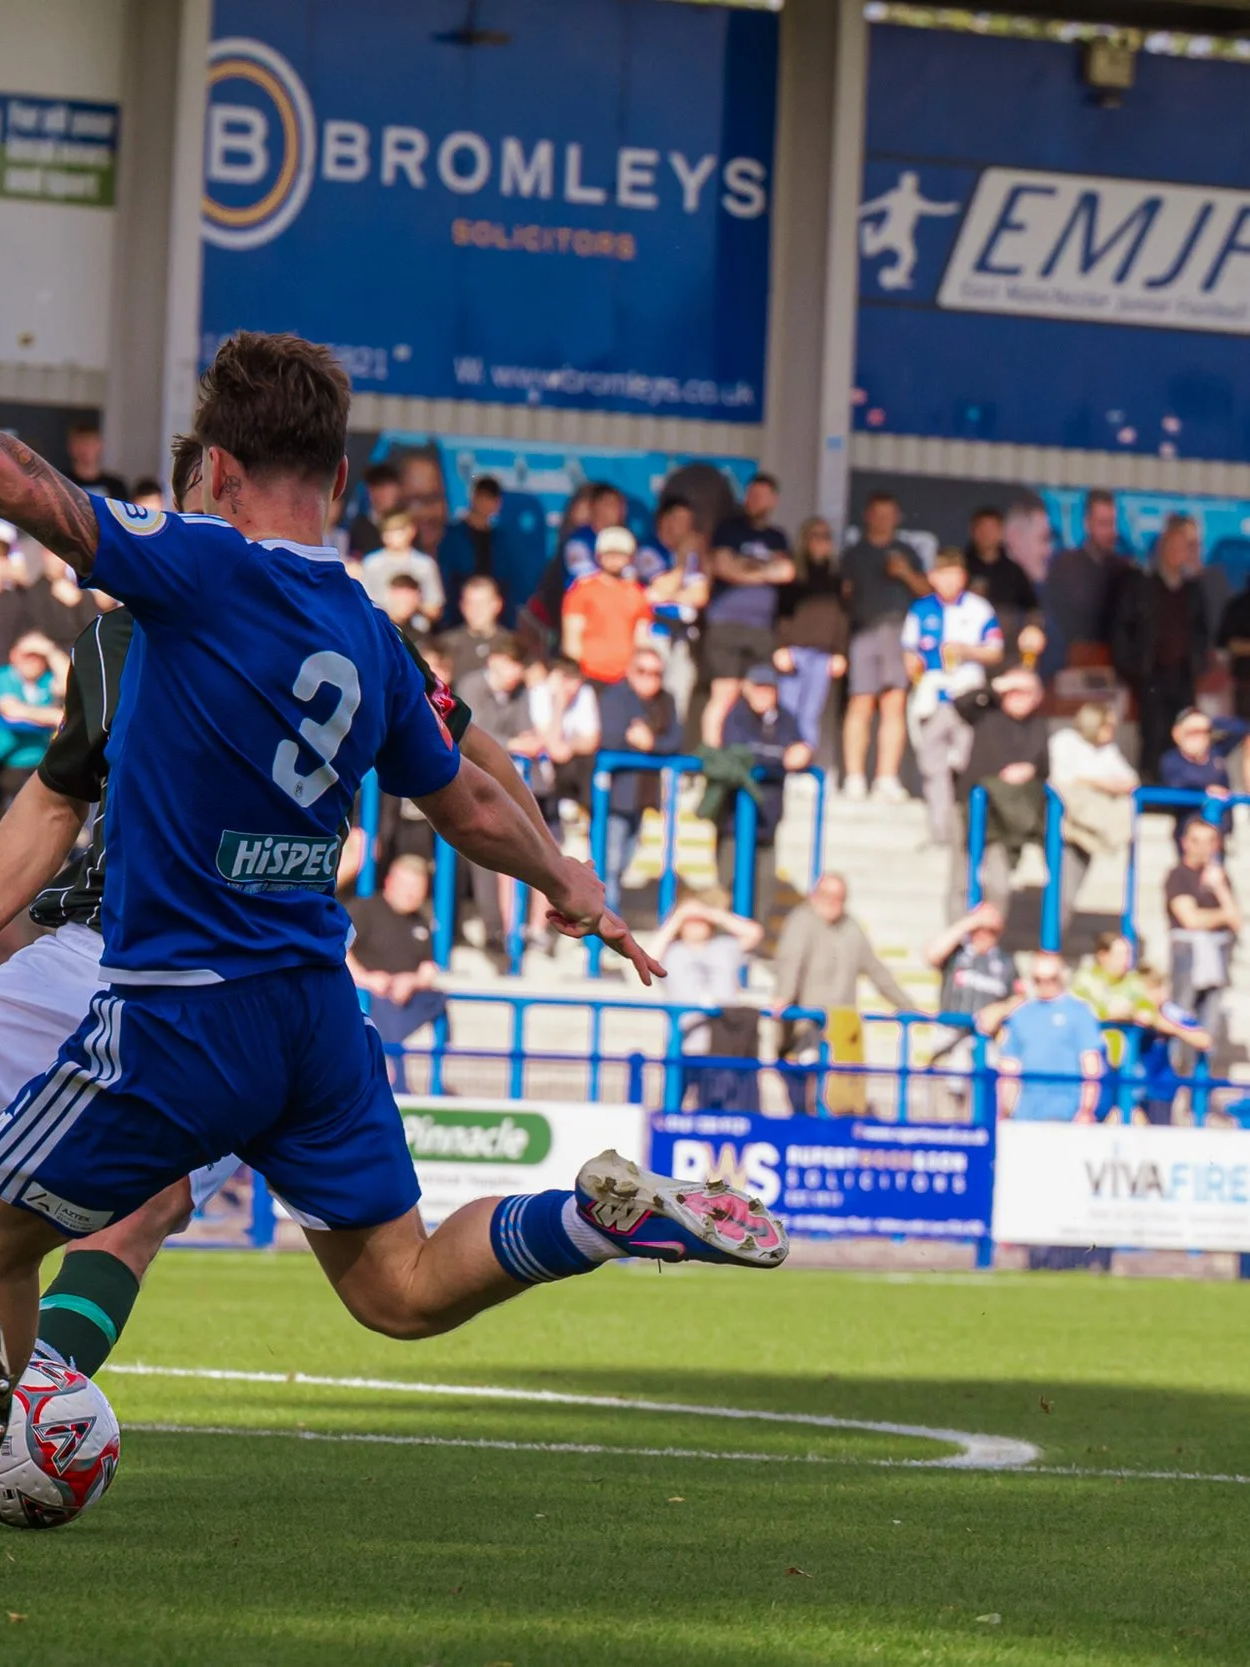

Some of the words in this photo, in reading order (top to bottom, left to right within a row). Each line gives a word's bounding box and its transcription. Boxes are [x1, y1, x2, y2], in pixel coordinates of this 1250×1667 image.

[207, 104, 269, 183] B
[322, 119, 767, 219] BROMLEYS
[452, 217, 636, 261] SOLICITORS
[272, 650, 361, 808] 3
